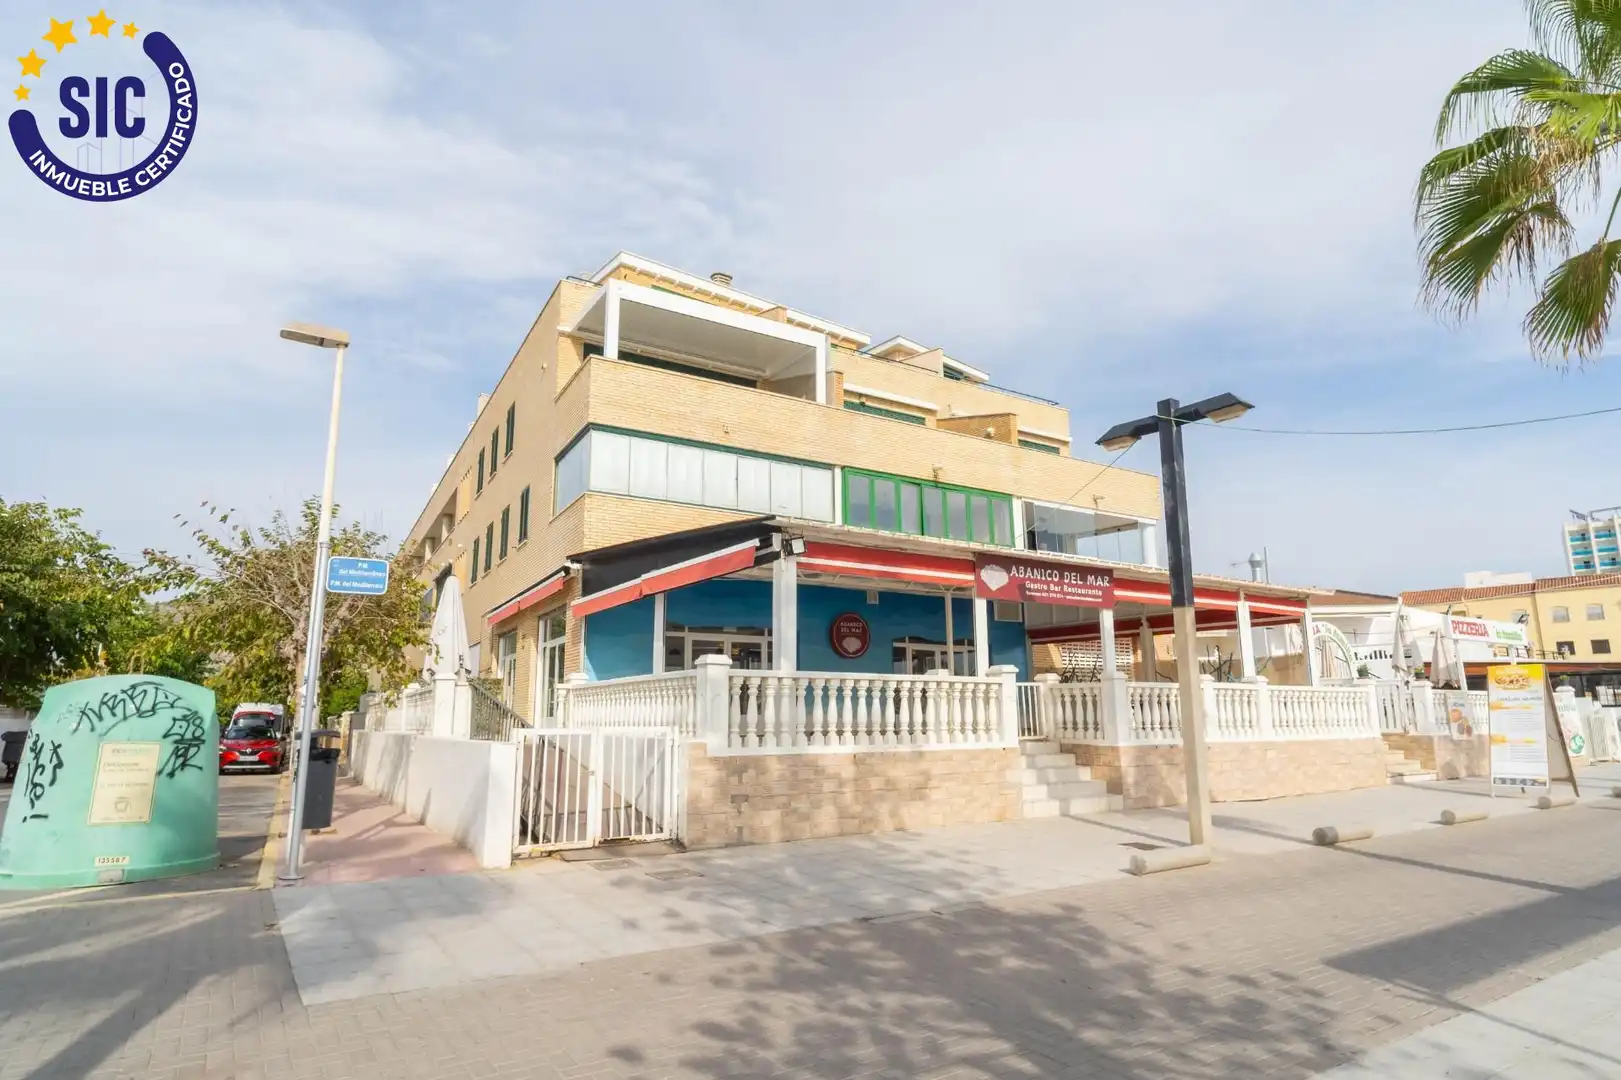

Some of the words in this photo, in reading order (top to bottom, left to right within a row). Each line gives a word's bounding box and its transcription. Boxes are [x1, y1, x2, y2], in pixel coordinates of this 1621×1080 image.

[1010, 565, 1059, 582] ABANICO
[1063, 572, 1083, 584] DEL
[1087, 574, 1110, 587] MAR
[1025, 581, 1048, 590] Gastro
[1050, 584, 1061, 592] Bar
[1063, 586, 1102, 596] Restaurante
[1451, 619, 1490, 637] PIZZERIA
